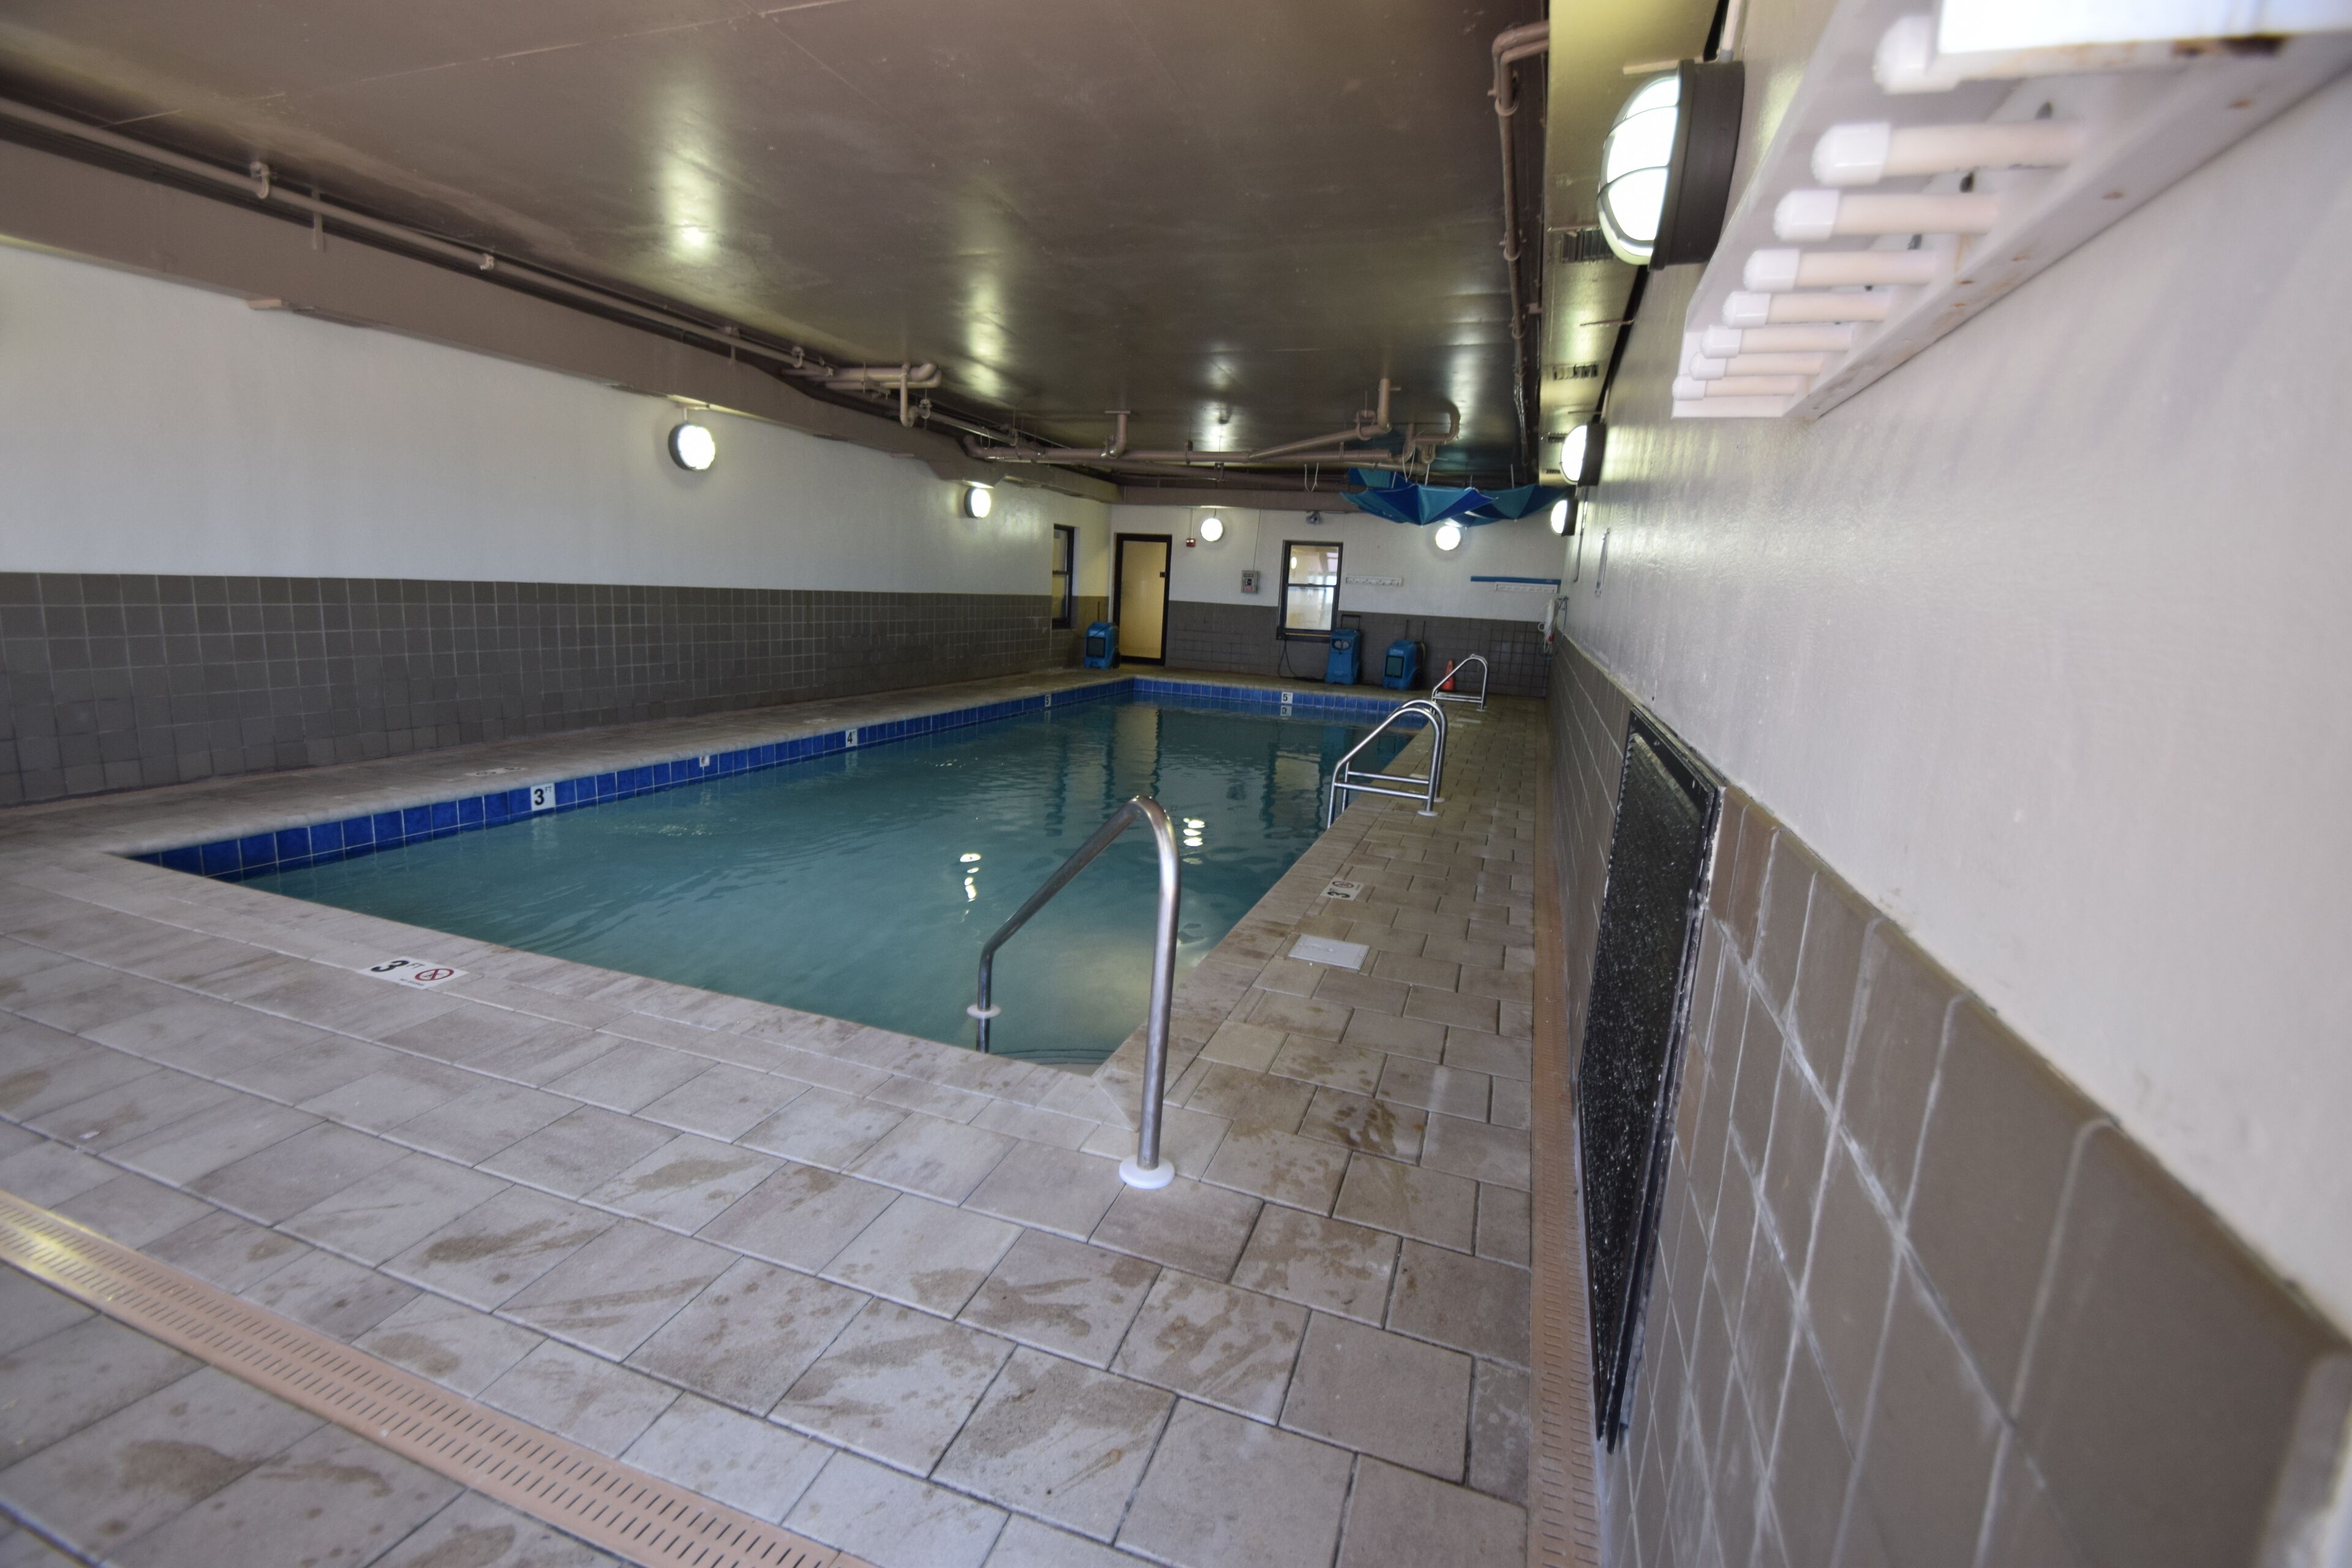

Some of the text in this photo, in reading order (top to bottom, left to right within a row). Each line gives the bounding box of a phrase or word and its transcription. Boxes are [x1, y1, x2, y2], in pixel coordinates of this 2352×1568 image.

[847, 731, 853, 744] 4
[534, 788, 545, 805] 3
[370, 960, 410, 972] 3
